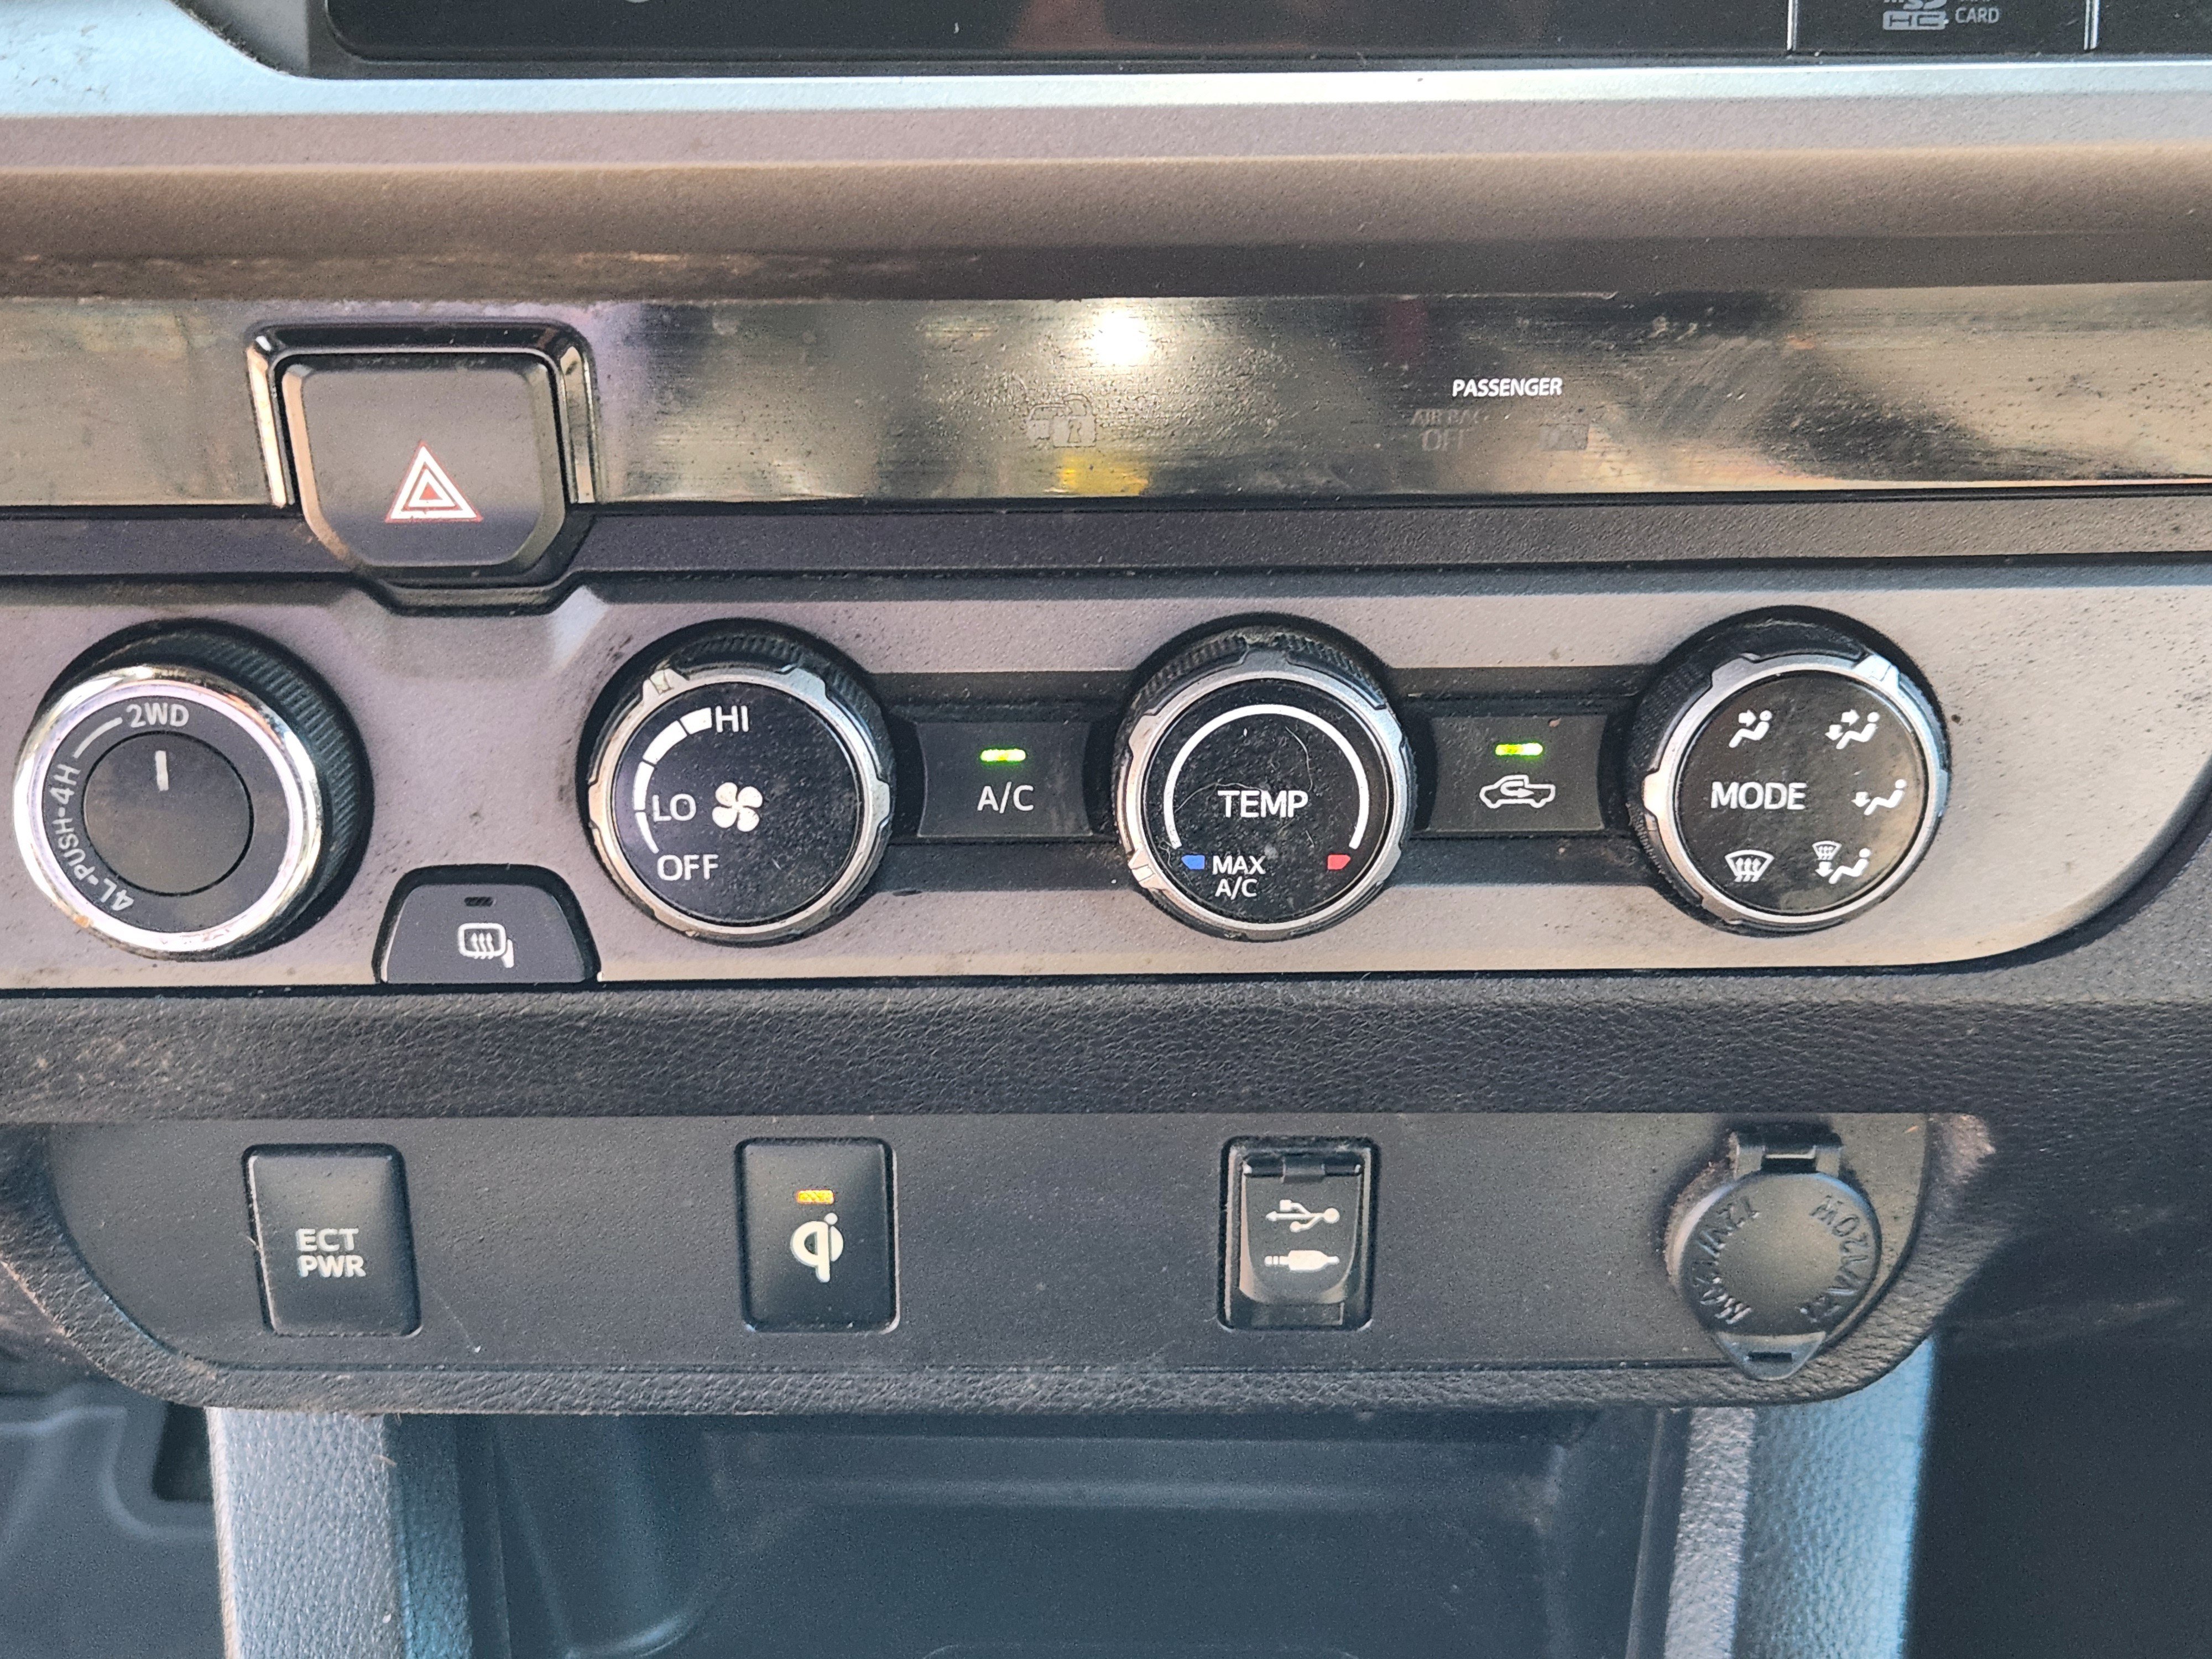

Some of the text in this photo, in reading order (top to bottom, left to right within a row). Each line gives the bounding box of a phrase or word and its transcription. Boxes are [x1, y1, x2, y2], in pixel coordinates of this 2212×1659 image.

[1955, 7, 2001, 24] CARD
[1452, 377, 1563, 398] PASSENGER
[126, 702, 189, 728] 2WD
[716, 705, 749, 733] HI
[653, 794, 697, 822] LO
[977, 781, 1035, 814] A/C
[1217, 789, 1309, 818] TEMP
[1710, 781, 1807, 811] MODE
[657, 854, 719, 881] OFF
[1212, 855, 1266, 875] MAX
[1215, 879, 1258, 900] A/C
[296, 1228, 359, 1251] ECT
[298, 1255, 367, 1278] PWR
